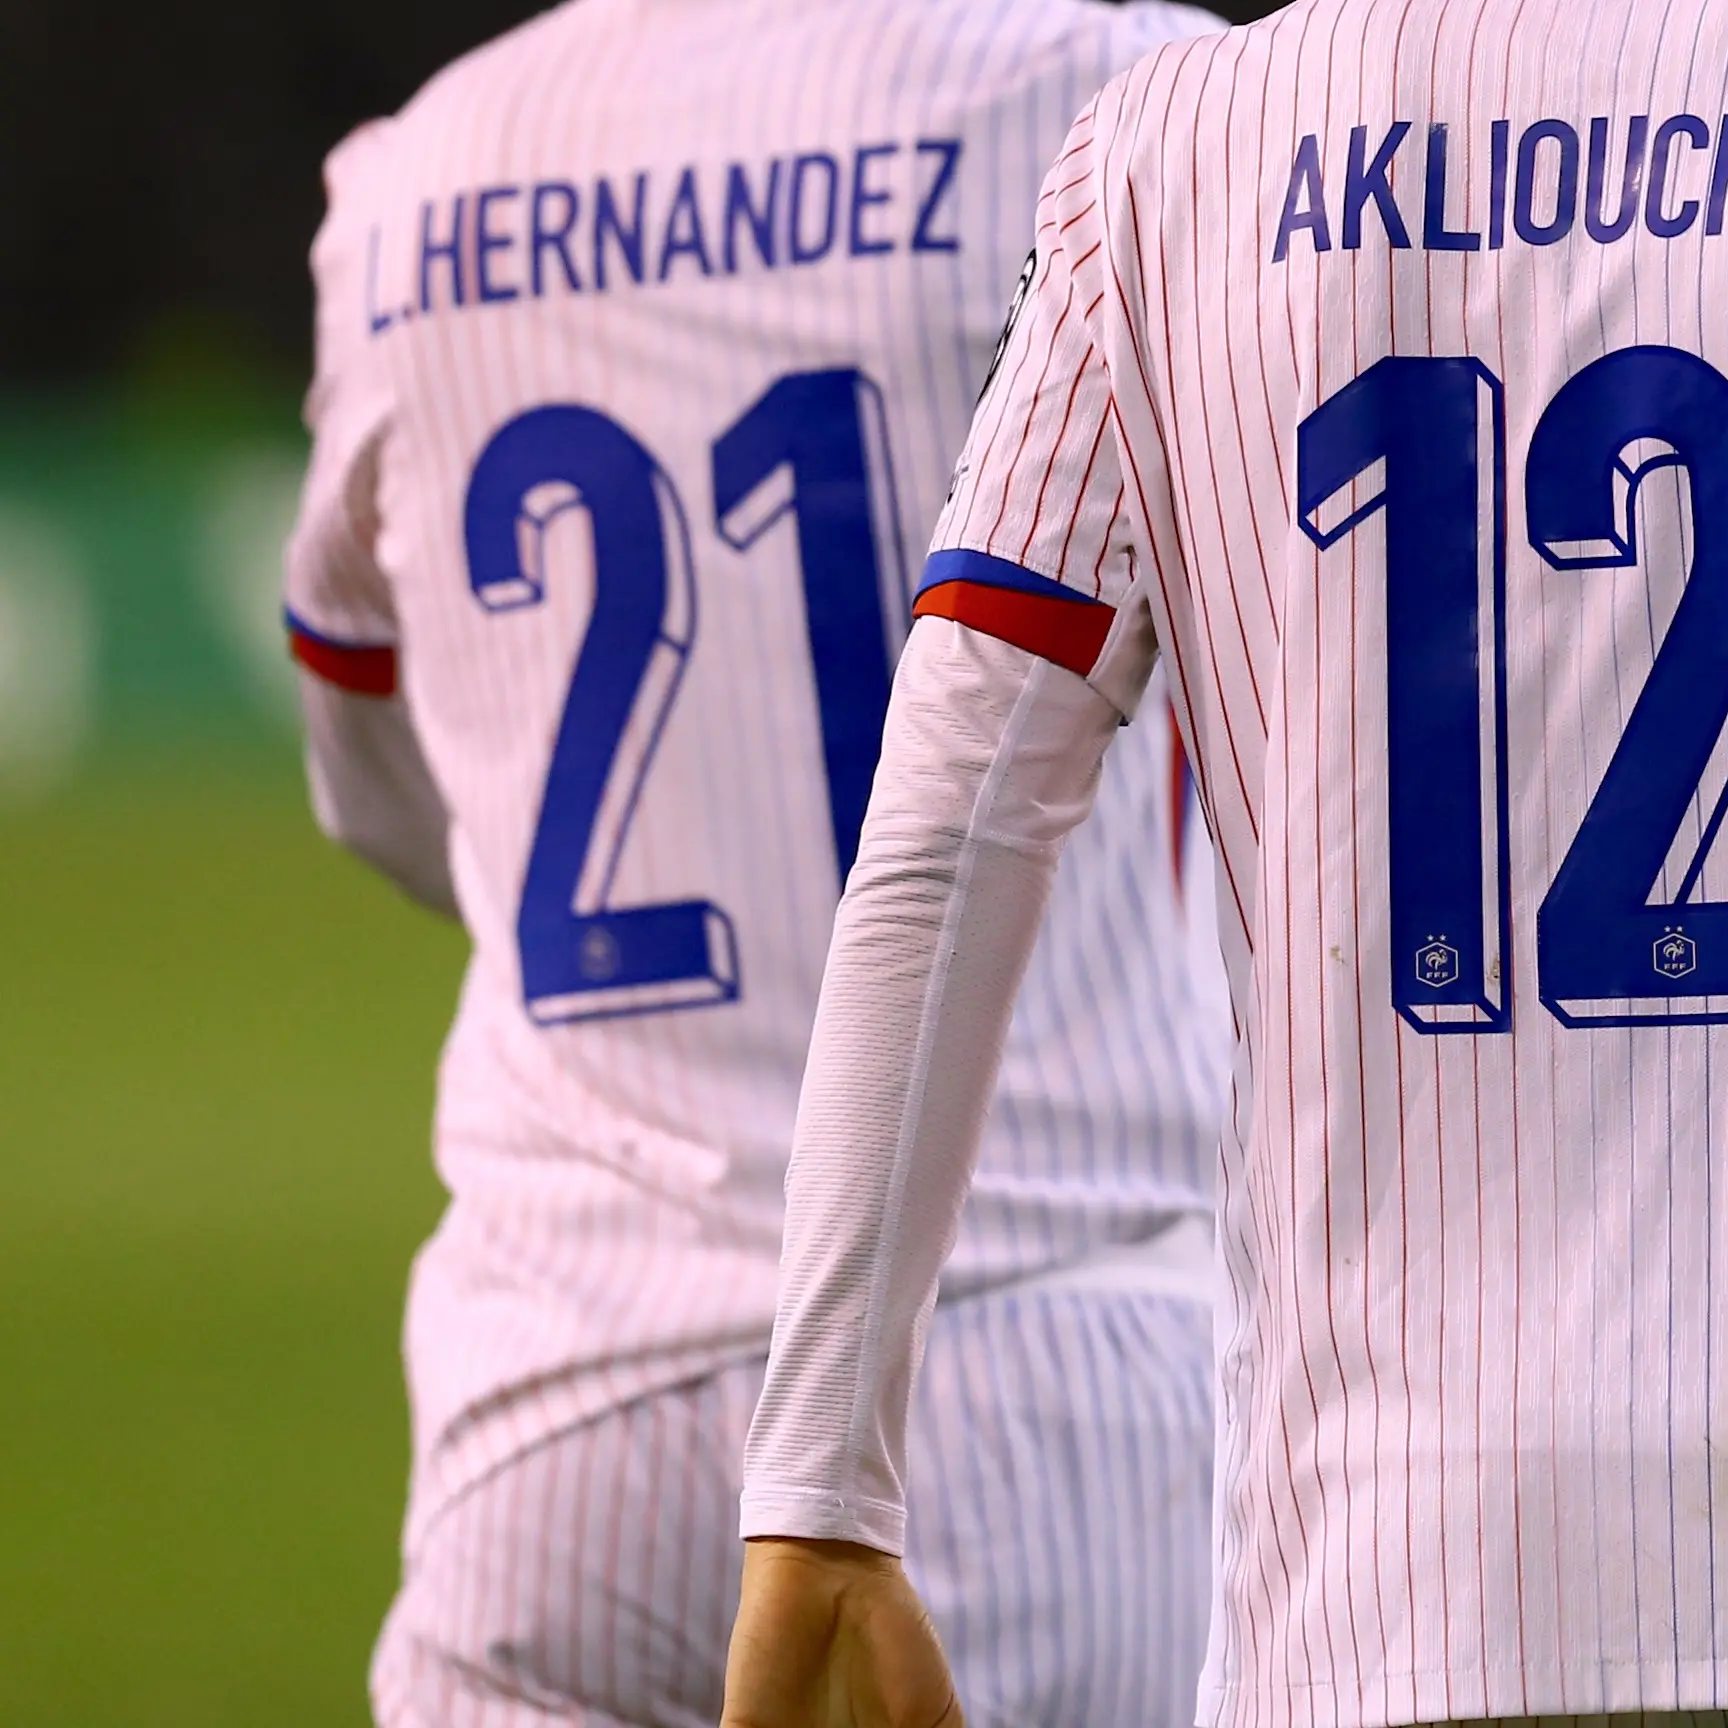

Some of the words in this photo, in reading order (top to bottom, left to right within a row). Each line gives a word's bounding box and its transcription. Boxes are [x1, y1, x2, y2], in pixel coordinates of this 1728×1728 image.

[370, 139, 965, 335] L.HERNANDEZ
[464, 365, 908, 1028] 21
[1426, 971, 1449, 979] FFF
[1664, 962, 1687, 970] FFF
